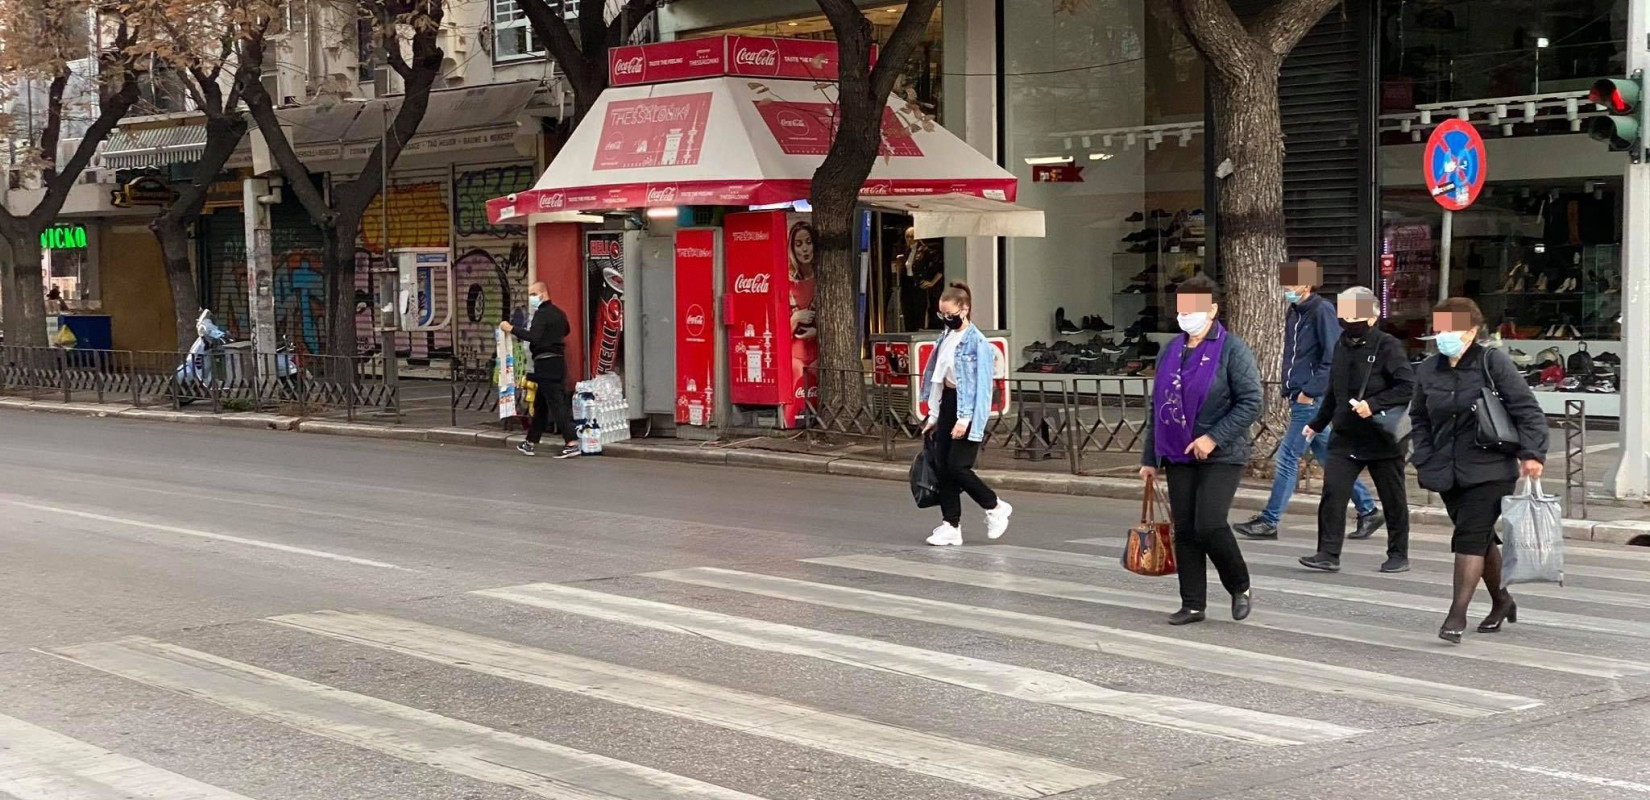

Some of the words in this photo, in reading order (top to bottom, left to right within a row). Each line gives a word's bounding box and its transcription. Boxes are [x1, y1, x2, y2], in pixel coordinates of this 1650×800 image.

[615, 56, 643, 75] Coca-Cola
[736, 47, 776, 66] Coca-Cola
[540, 192, 564, 208] Coca-Cola
[648, 186, 676, 202] Coca-Cola
[590, 240, 610, 256] HELL
[734, 273, 770, 294] Coca-Cola
[596, 326, 618, 376] HELL
